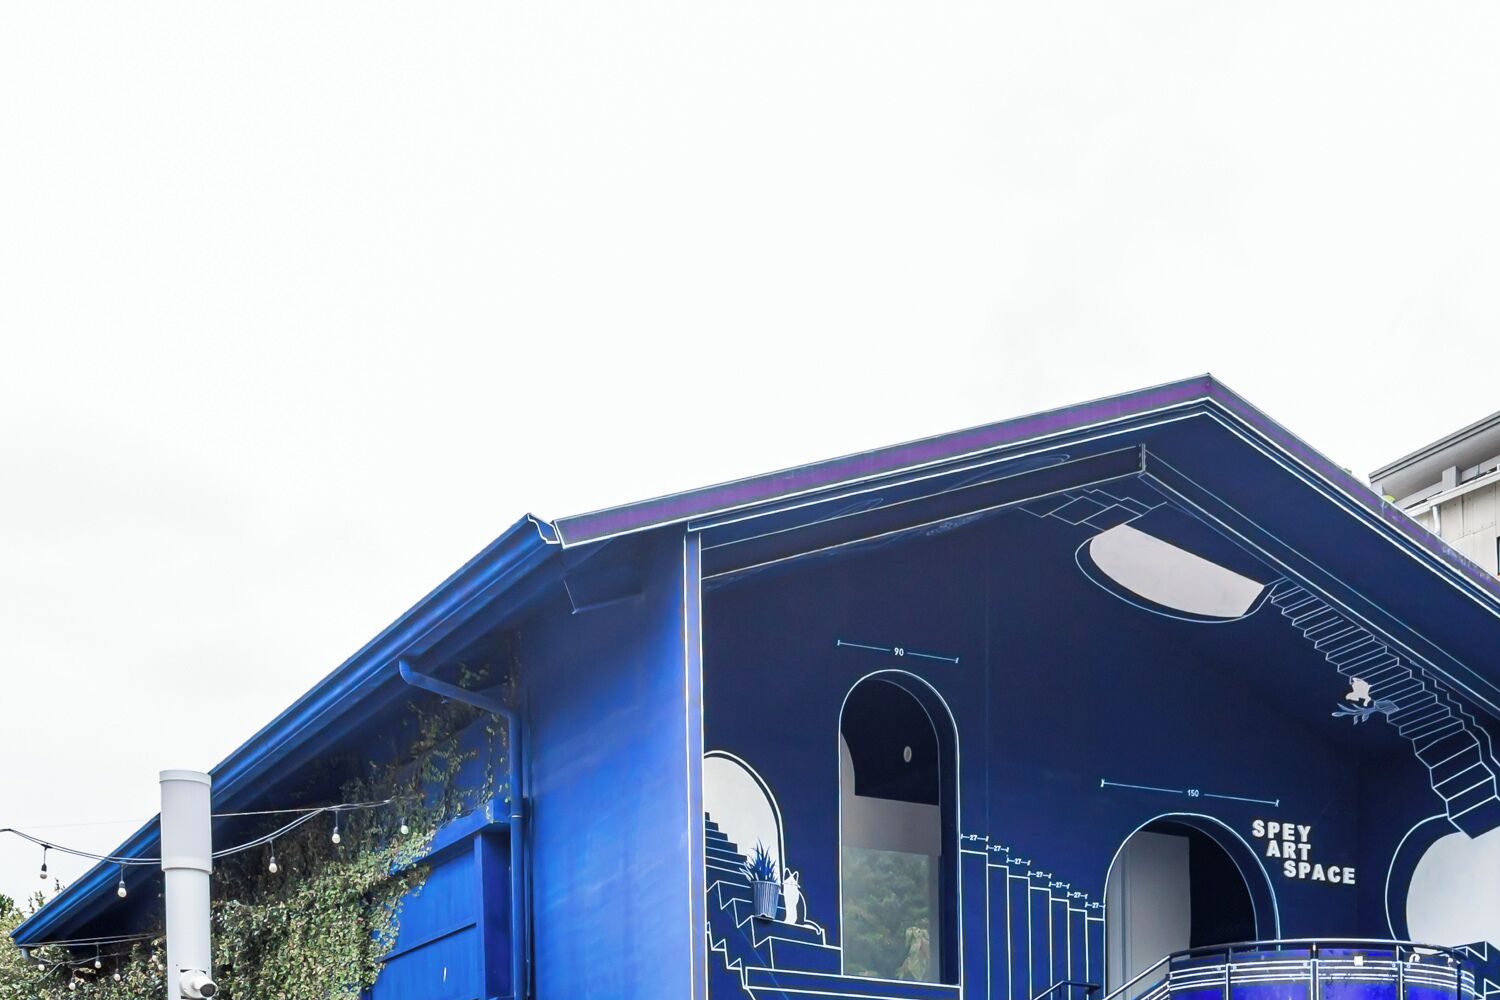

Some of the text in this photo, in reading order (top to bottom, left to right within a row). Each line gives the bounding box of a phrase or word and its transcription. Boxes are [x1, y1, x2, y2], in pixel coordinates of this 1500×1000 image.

[894, 647, 904, 656] 90
[1187, 789, 1199, 797] 150
[1252, 819, 1311, 842] SPEY
[1266, 840, 1311, 860] ART
[1283, 860, 1355, 884] SPACE
